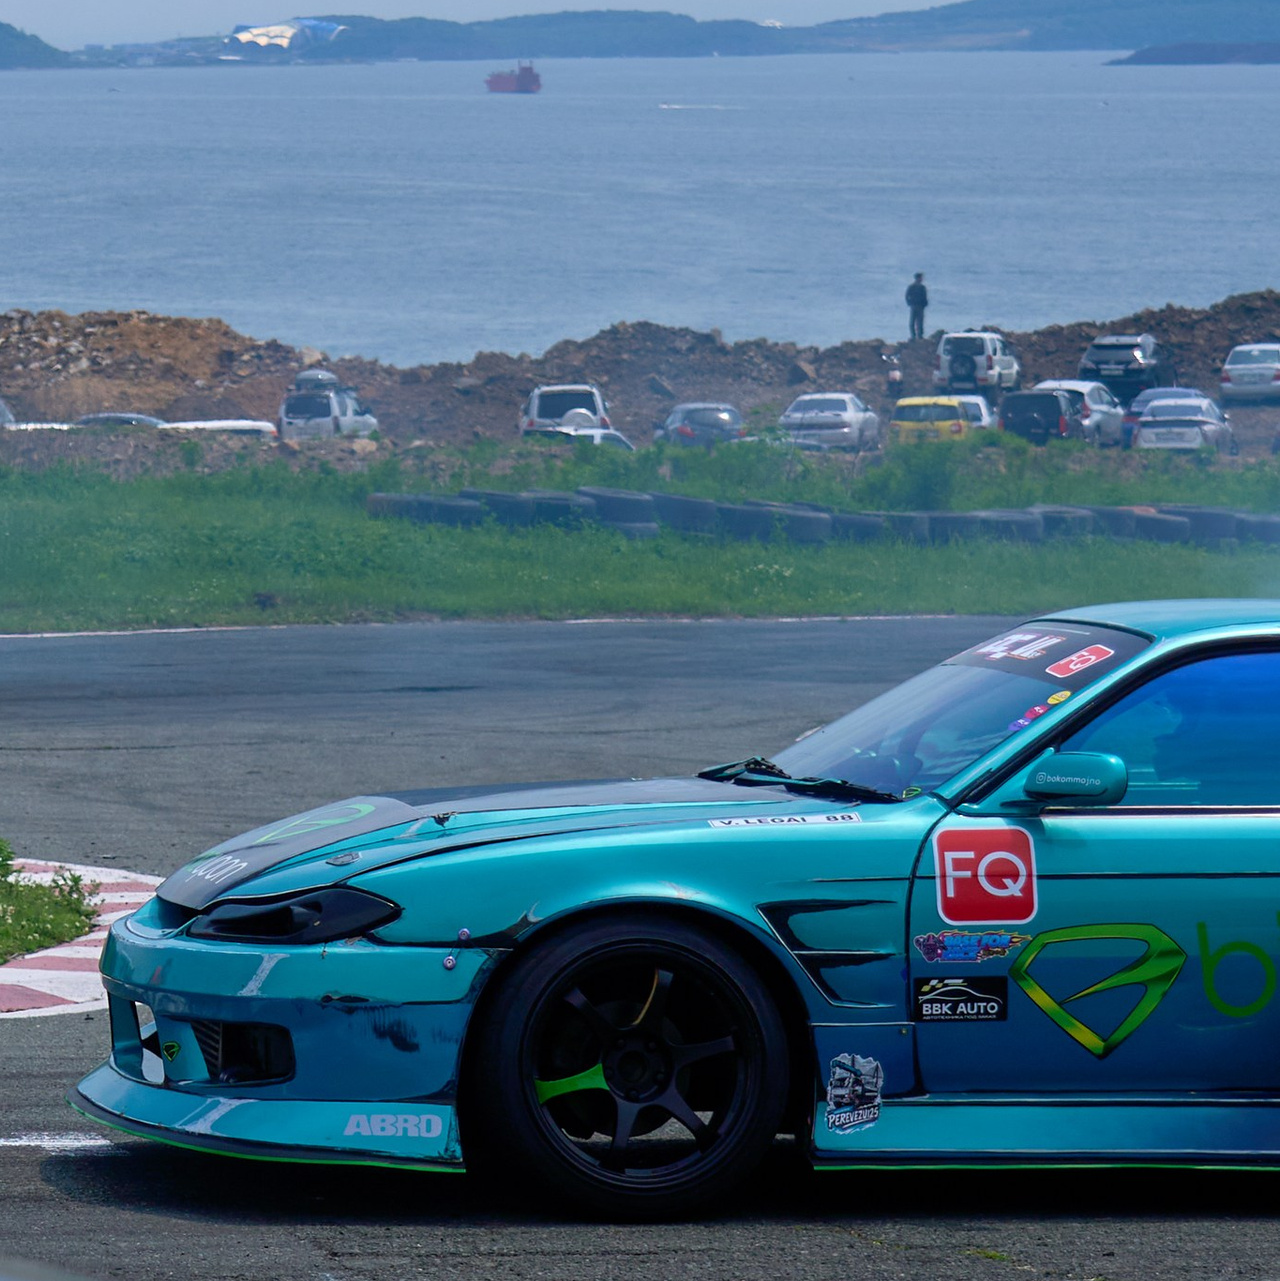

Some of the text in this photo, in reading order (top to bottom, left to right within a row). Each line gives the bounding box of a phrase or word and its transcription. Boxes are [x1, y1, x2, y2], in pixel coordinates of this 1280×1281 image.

[825, 813, 855, 822] 88
[943, 851, 1027, 898] FQ
[1197, 920, 1280, 1018] b
[922, 1001, 999, 1015] BBK AUTO
[343, 1114, 442, 1138] ABRO
[827, 1106, 880, 1128] PEREVEZU125
